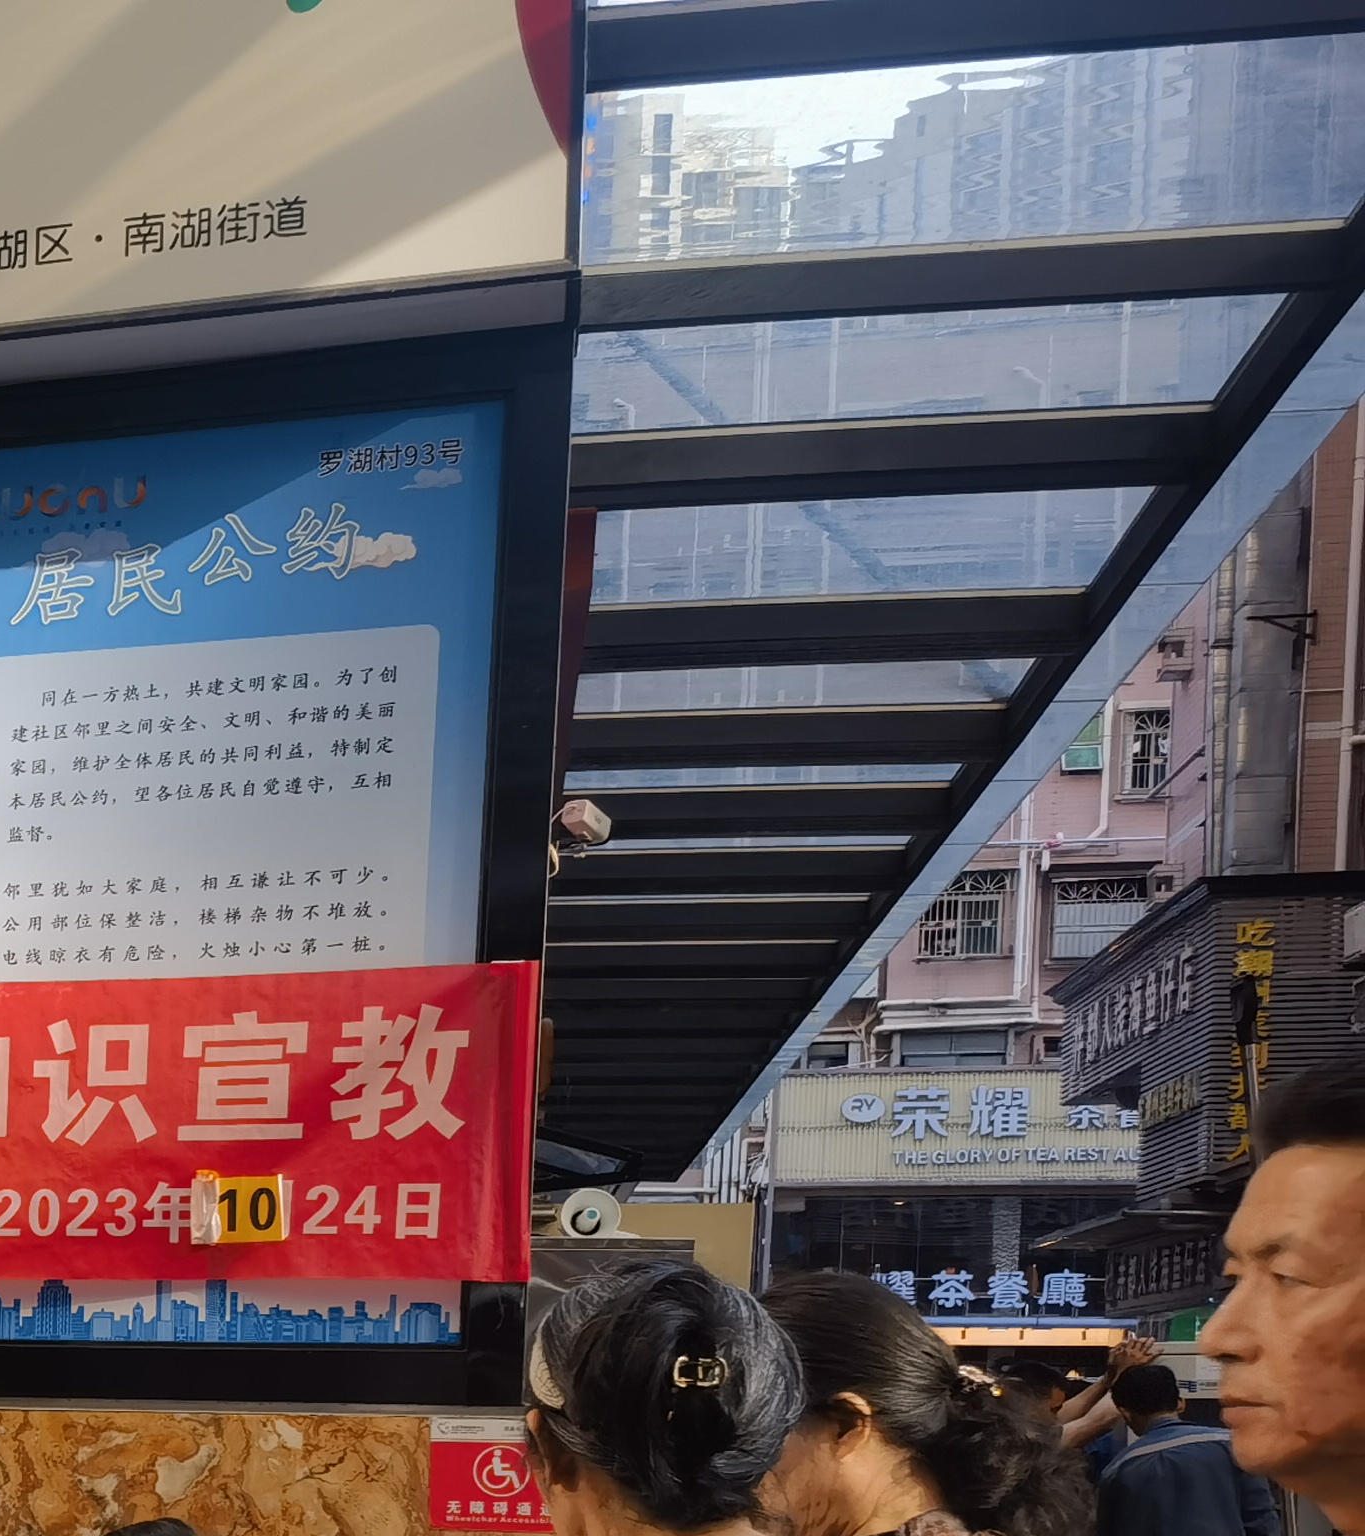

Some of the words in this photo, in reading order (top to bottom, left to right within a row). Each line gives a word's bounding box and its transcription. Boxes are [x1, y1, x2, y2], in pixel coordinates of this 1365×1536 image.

[318, 438, 465, 477] 罗湖村93号
[10, 502, 361, 627] 居民公约
[891, 1086, 1030, 1139] 荣耀
[893, 1150, 928, 1165] THE
[932, 1149, 993, 1164] GLORY
[997, 1148, 1021, 1162] OF
[1025, 1147, 1059, 1161] TEA
[1064, 1147, 1110, 1161] REST
